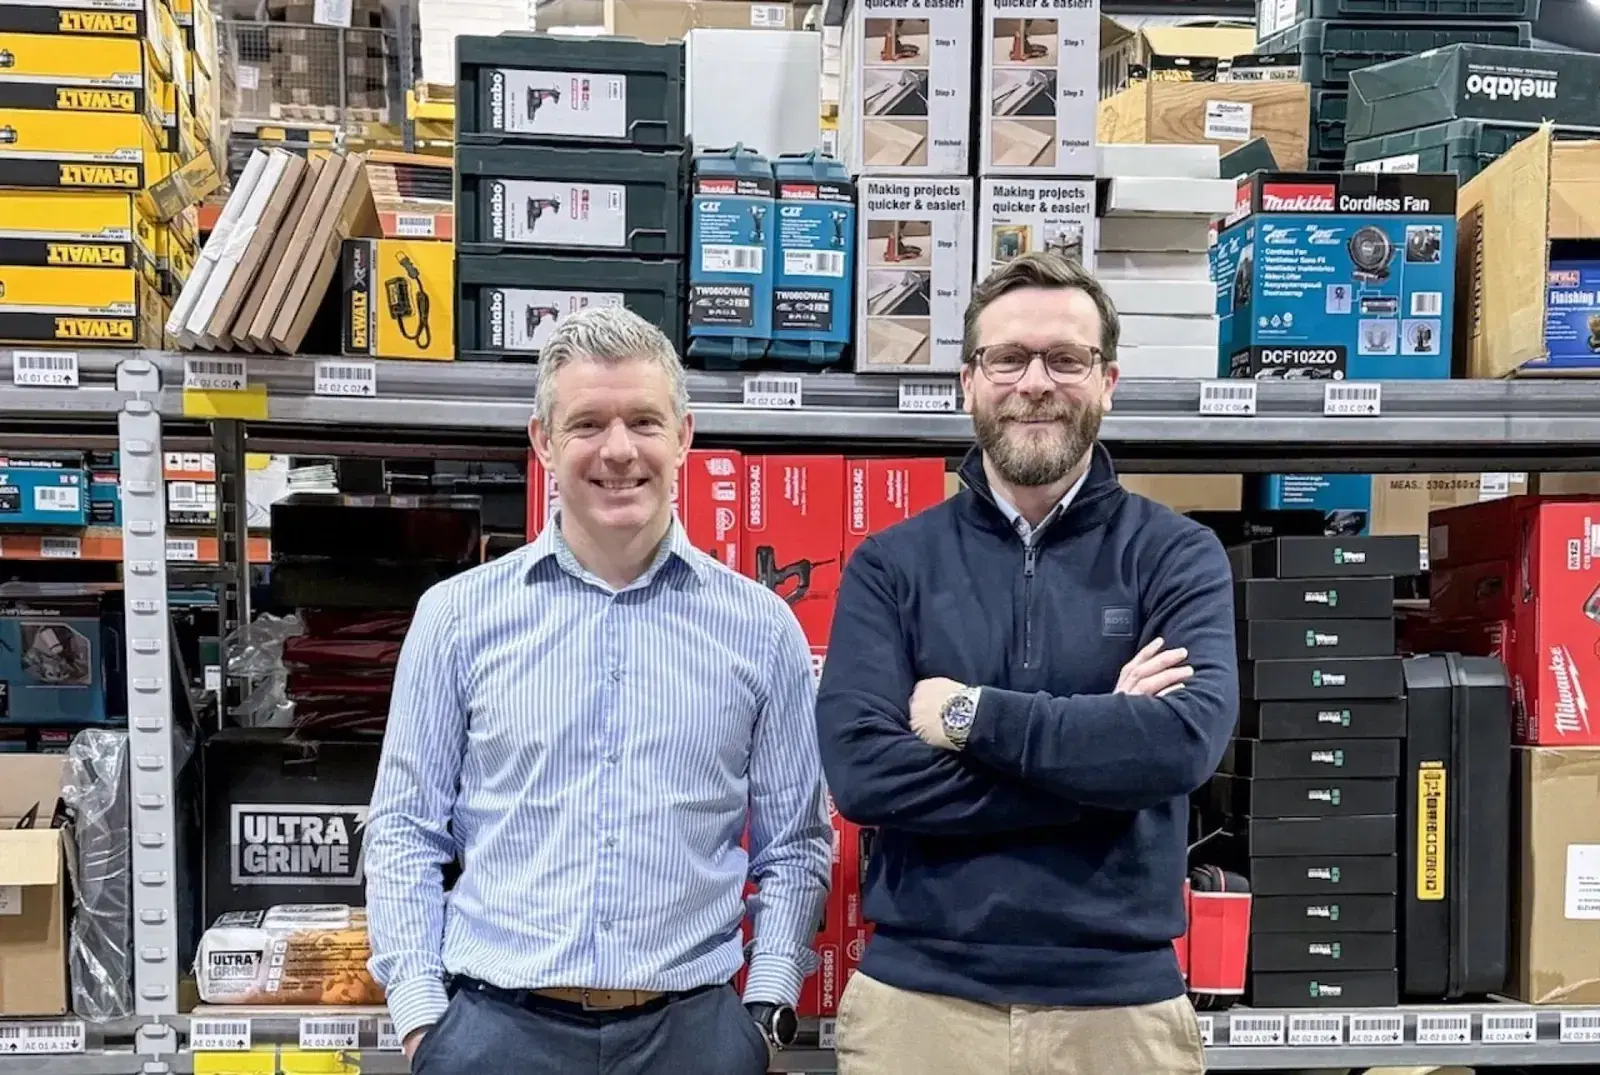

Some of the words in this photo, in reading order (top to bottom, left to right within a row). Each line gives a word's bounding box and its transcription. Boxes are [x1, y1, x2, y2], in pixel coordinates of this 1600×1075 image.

[1465, 75, 1558, 101] metabo
[868, 184, 910, 198] Making
[914, 185, 960, 198] projects
[993, 186, 1035, 198] Making
[1038, 186, 1085, 200] projects
[868, 200, 911, 212] quicker
[914, 200, 923, 210] &
[926, 200, 966, 210] easier!
[992, 202, 1036, 214] quicker
[1039, 202, 1048, 212] &
[1051, 202, 1090, 214] easier!
[1340, 195, 1400, 212] Cordless
[1404, 196, 1430, 212] Fan
[1551, 291, 1594, 306] Finishing
[1262, 350, 1338, 364] DCF102ZO
[52, 374, 62, 382] 12
[1549, 646, 1582, 737] Milwaukee
[244, 816, 349, 844] ULTRA
[244, 845, 349, 874] GRIME
[214, 955, 253, 966] ULTRA
